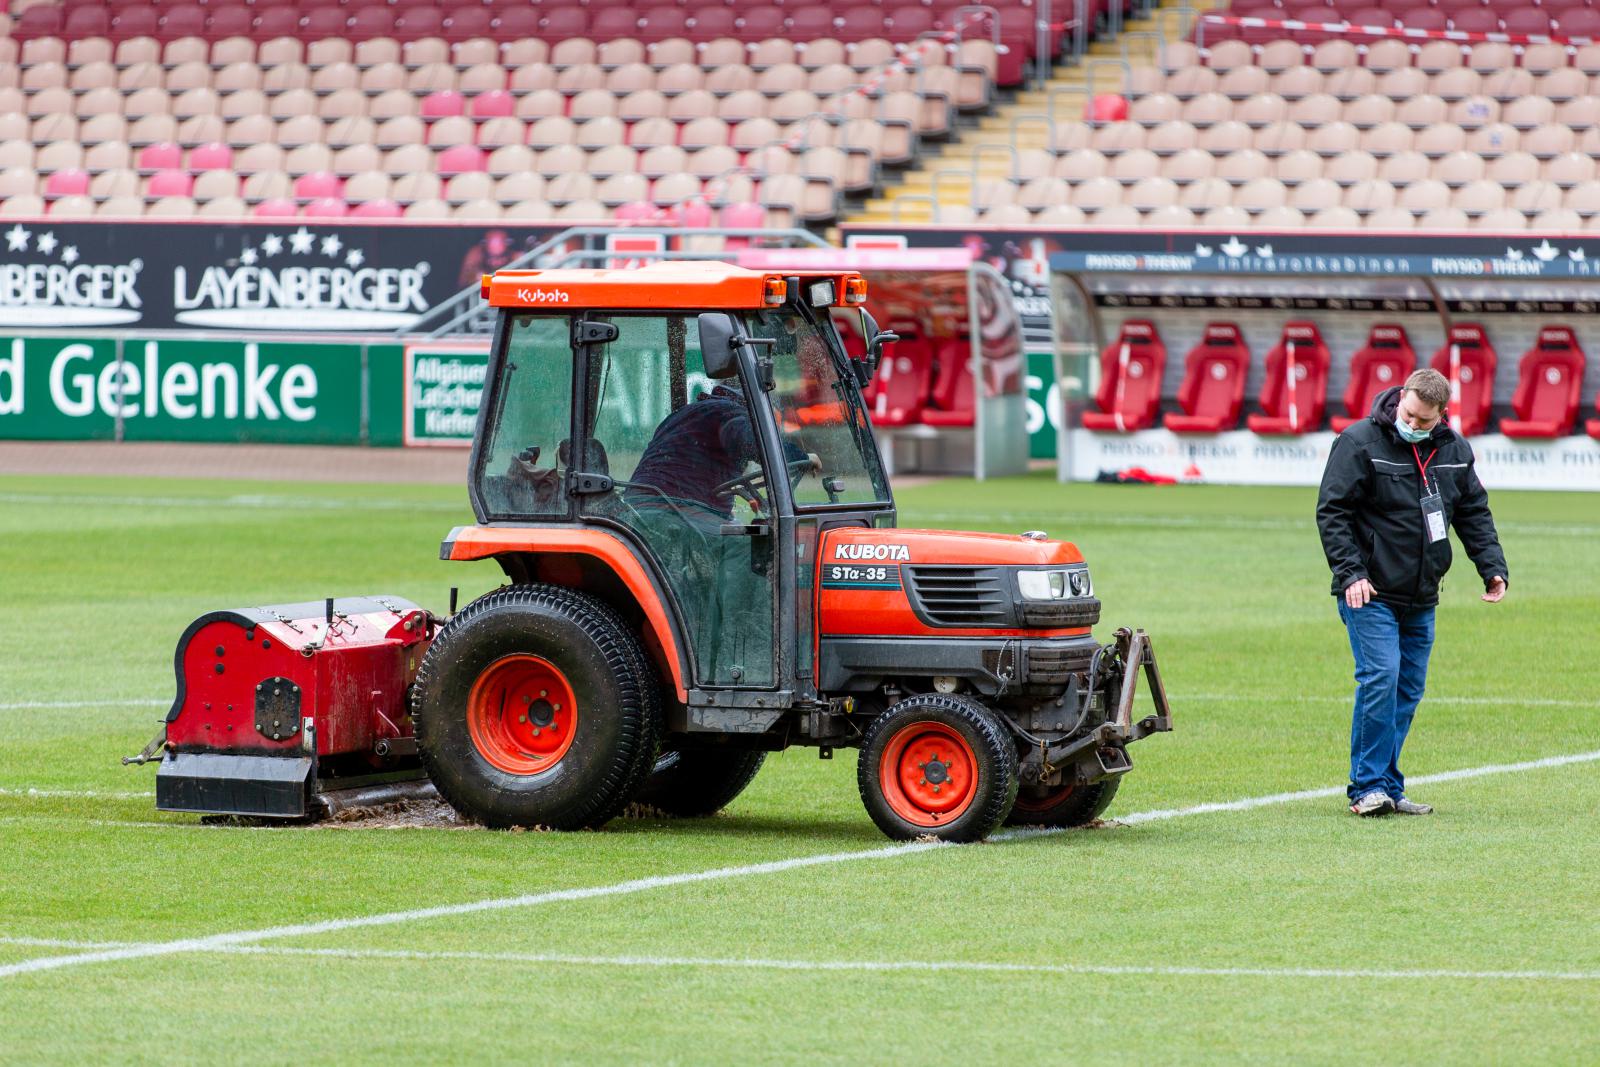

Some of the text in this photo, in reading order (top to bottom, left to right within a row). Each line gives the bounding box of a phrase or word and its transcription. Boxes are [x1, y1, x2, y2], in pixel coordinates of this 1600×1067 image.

[174, 265, 430, 312] LAYENBERGER
[517, 288, 569, 303] Kubota
[49, 341, 318, 421] Gelenke
[835, 543, 910, 561] KUBOTA
